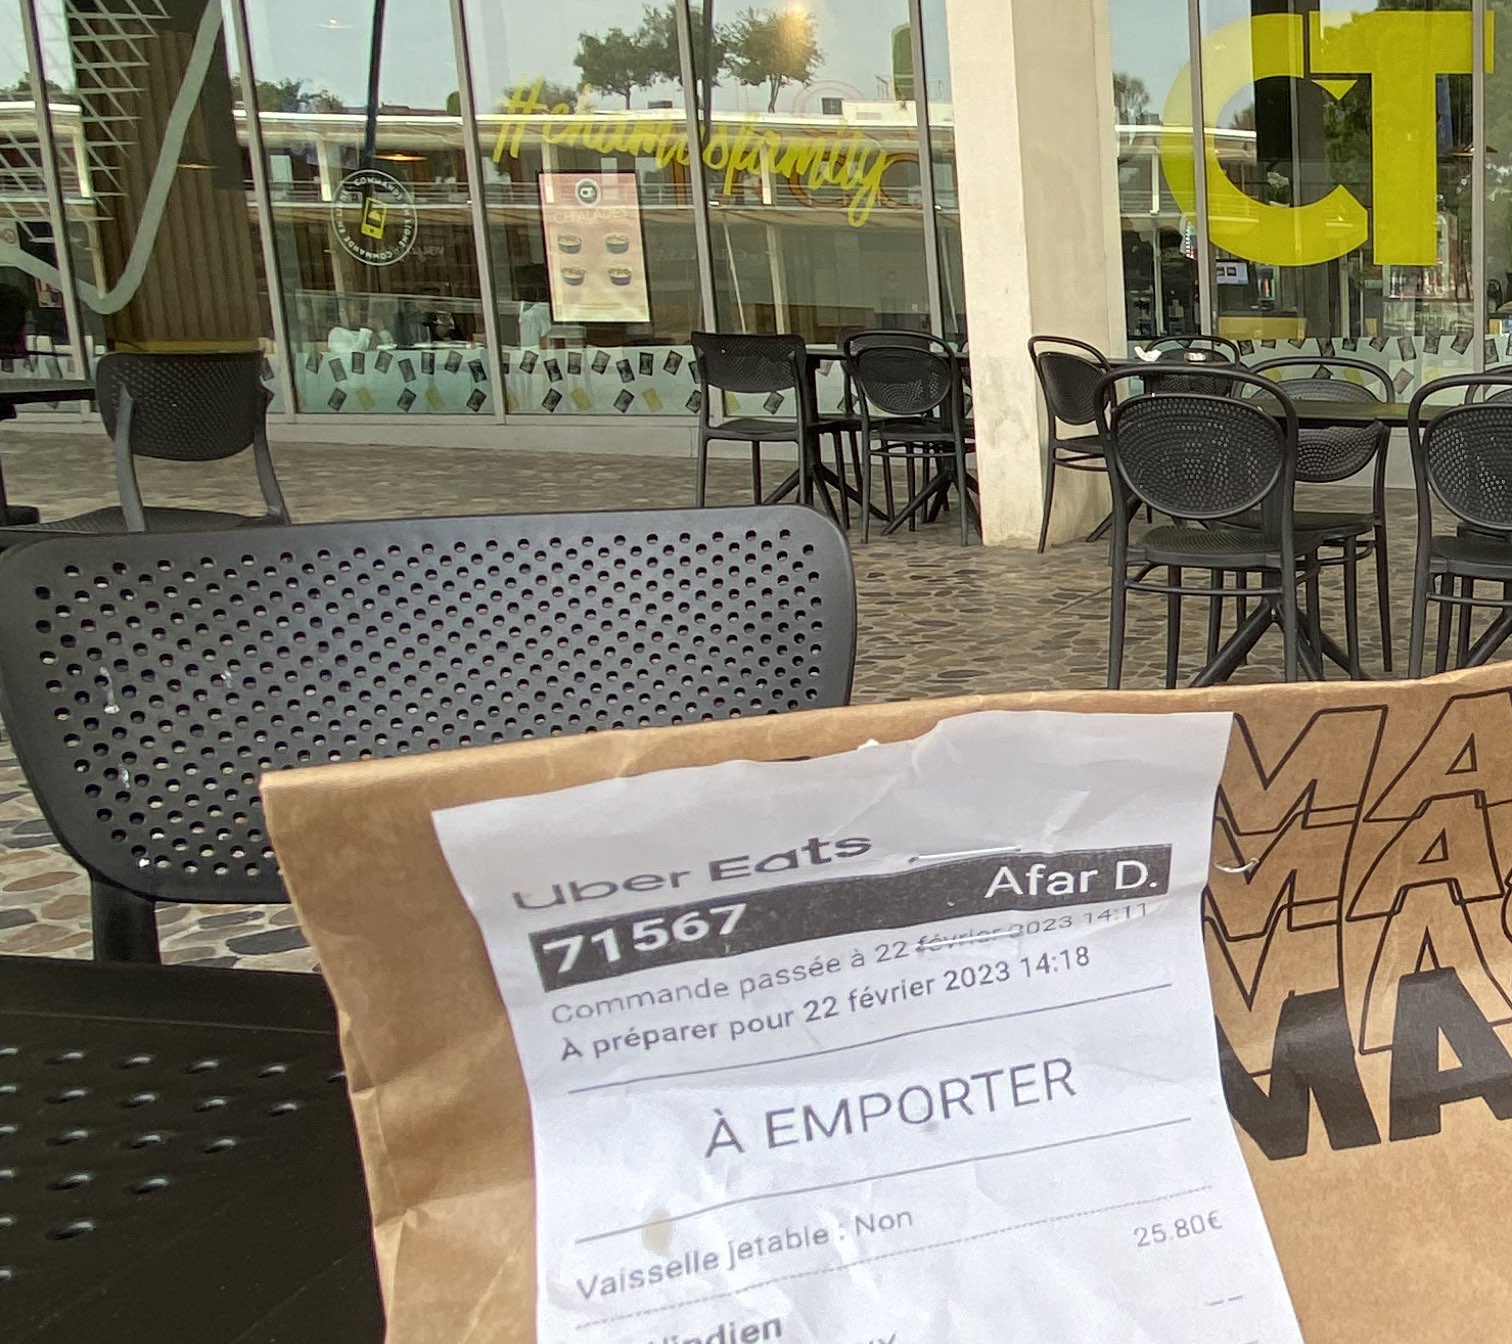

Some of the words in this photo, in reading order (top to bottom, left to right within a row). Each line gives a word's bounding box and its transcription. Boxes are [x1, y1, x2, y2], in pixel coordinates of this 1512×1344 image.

[511, 870, 691, 910] Uber
[708, 836, 872, 882] Eats
[542, 902, 748, 974] 71567
[984, 862, 1099, 900] Afar
[1115, 859, 1158, 891] D.
[551, 977, 730, 1025] Commande
[739, 955, 842, 1000] passée
[850, 947, 867, 969] à
[875, 940, 909, 964] 22
[1084, 902, 1148, 924] 14:11
[560, 1036, 584, 1061] À
[593, 1019, 720, 1058] préparer
[730, 1007, 796, 1041] pour
[802, 994, 840, 1024] 22
[848, 975, 935, 1012] février
[943, 959, 1011, 991] 2023
[1020, 944, 1091, 978] 14:18
[704, 1107, 745, 1159] À
[765, 1056, 1077, 1149] EMPORTER
[576, 1249, 720, 1300] Vaisselle
[727, 1224, 829, 1271] jetable
[854, 1208, 913, 1237] Non
[1133, 1209, 1223, 1248] 25.80€
